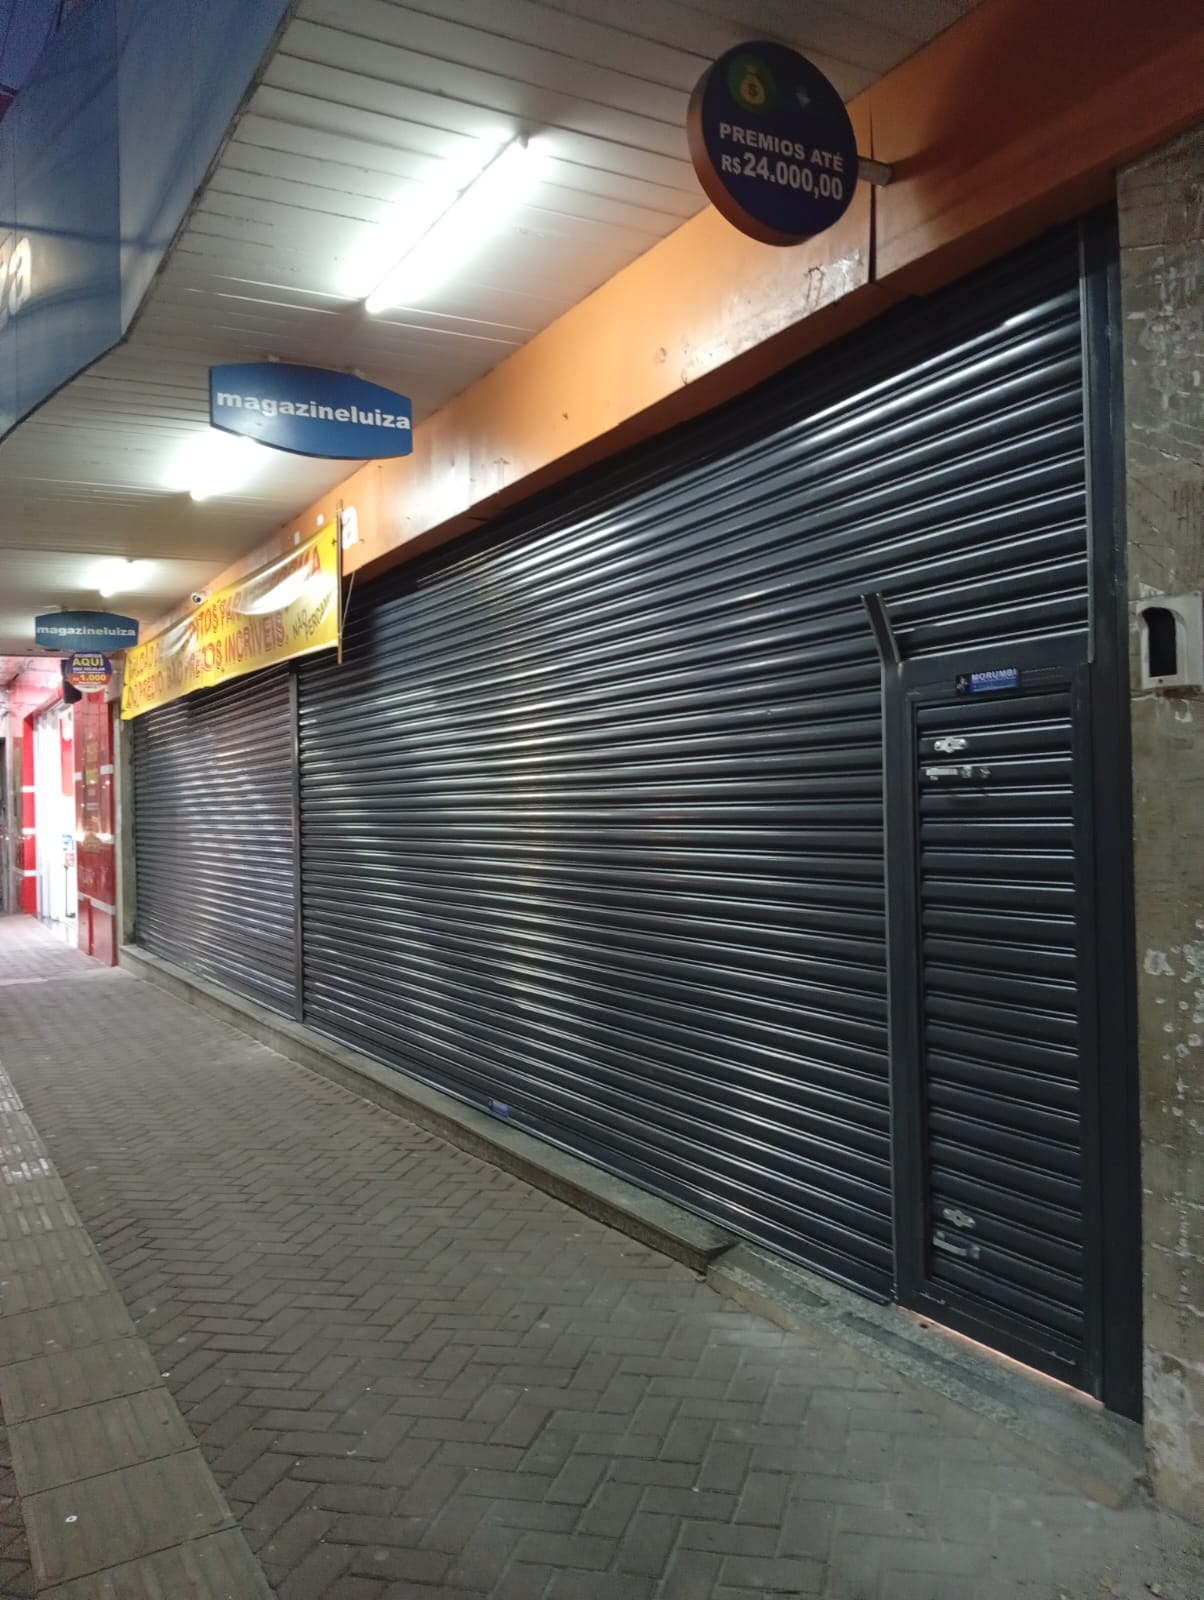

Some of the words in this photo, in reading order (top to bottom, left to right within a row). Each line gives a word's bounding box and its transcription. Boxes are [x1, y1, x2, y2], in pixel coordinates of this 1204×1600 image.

[719, 122, 805, 161] PREMIOS
[810, 148, 844, 172] ATÉ
[216, 391, 411, 430] magazineluiza
[37, 626, 136, 637] magazineluiza
[72, 657, 104, 667] AQUI
[971, 667, 1017, 682] MORUMBI
